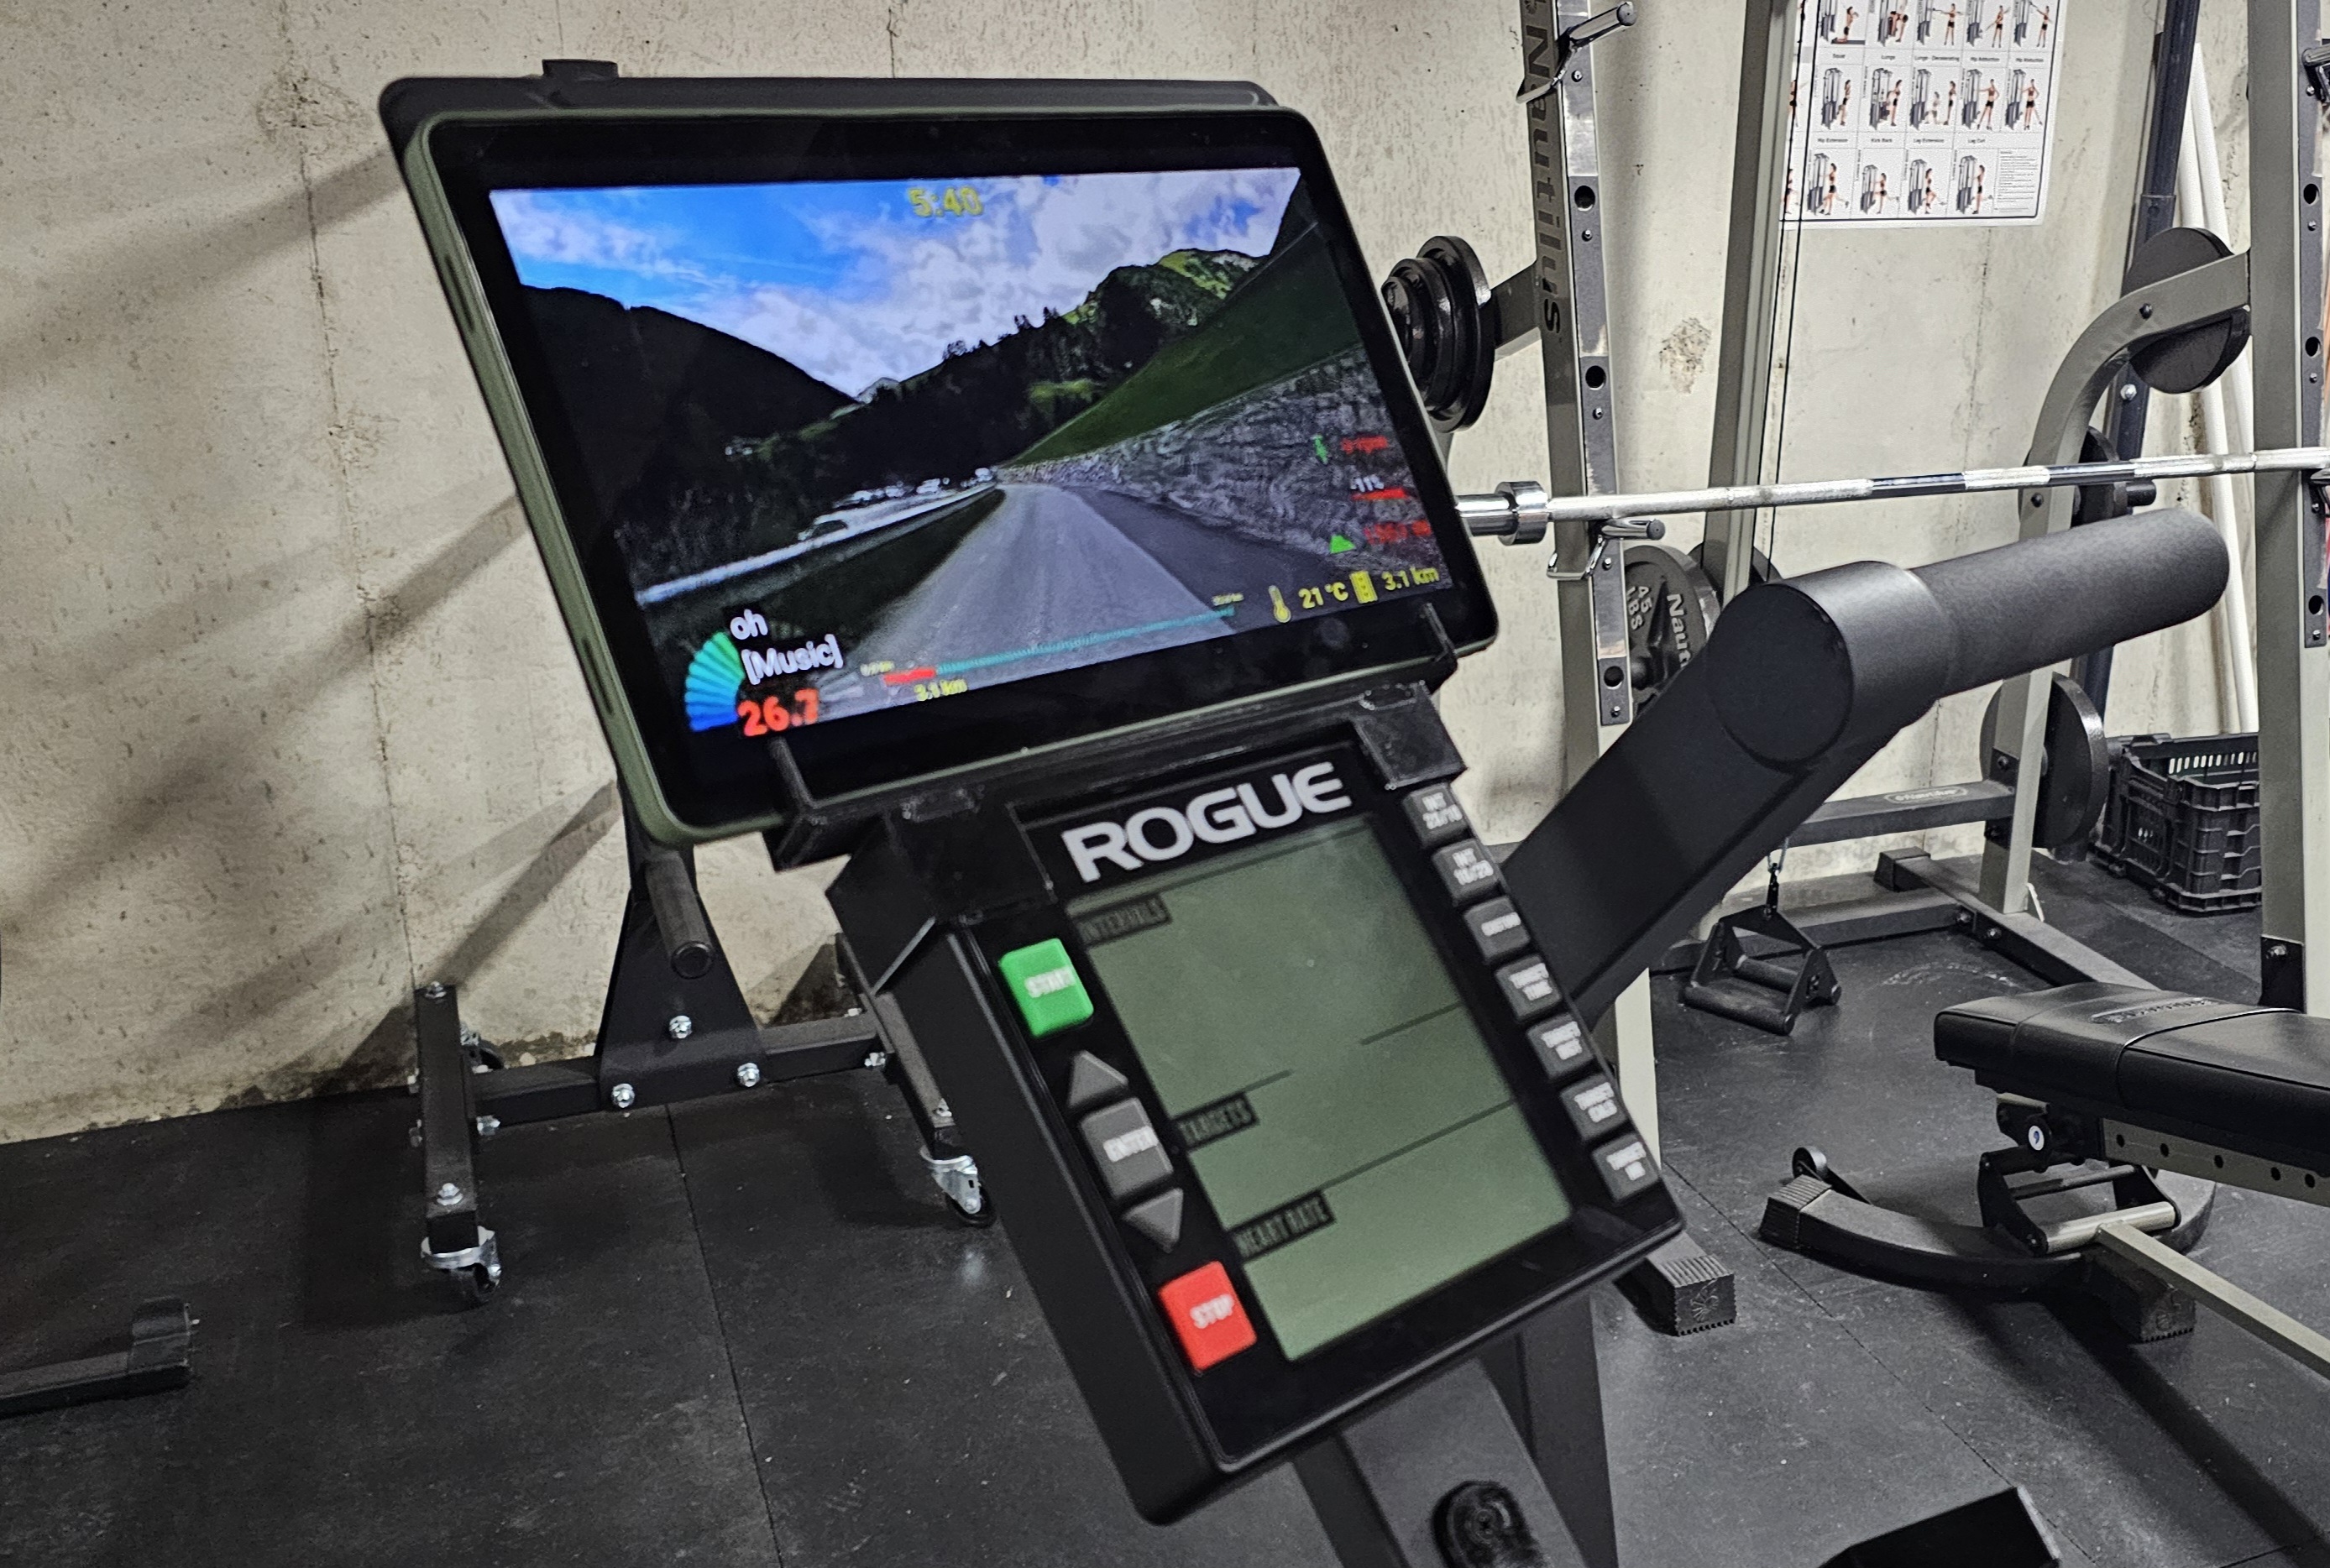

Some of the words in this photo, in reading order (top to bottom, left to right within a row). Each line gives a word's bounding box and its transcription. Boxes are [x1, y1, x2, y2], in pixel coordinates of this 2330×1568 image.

[908, 186, 984, 217] 5:40
[1382, 572, 1410, 591] 3.1
[1411, 566, 1440, 585] km
[1299, 588, 1324, 609] 21
[1638, 586, 1652, 613] 45
[730, 609, 768, 640] oh
[741, 634, 844, 685] [Music]
[737, 688, 819, 736] 26.7
[1061, 761, 1353, 882] ROGUE
